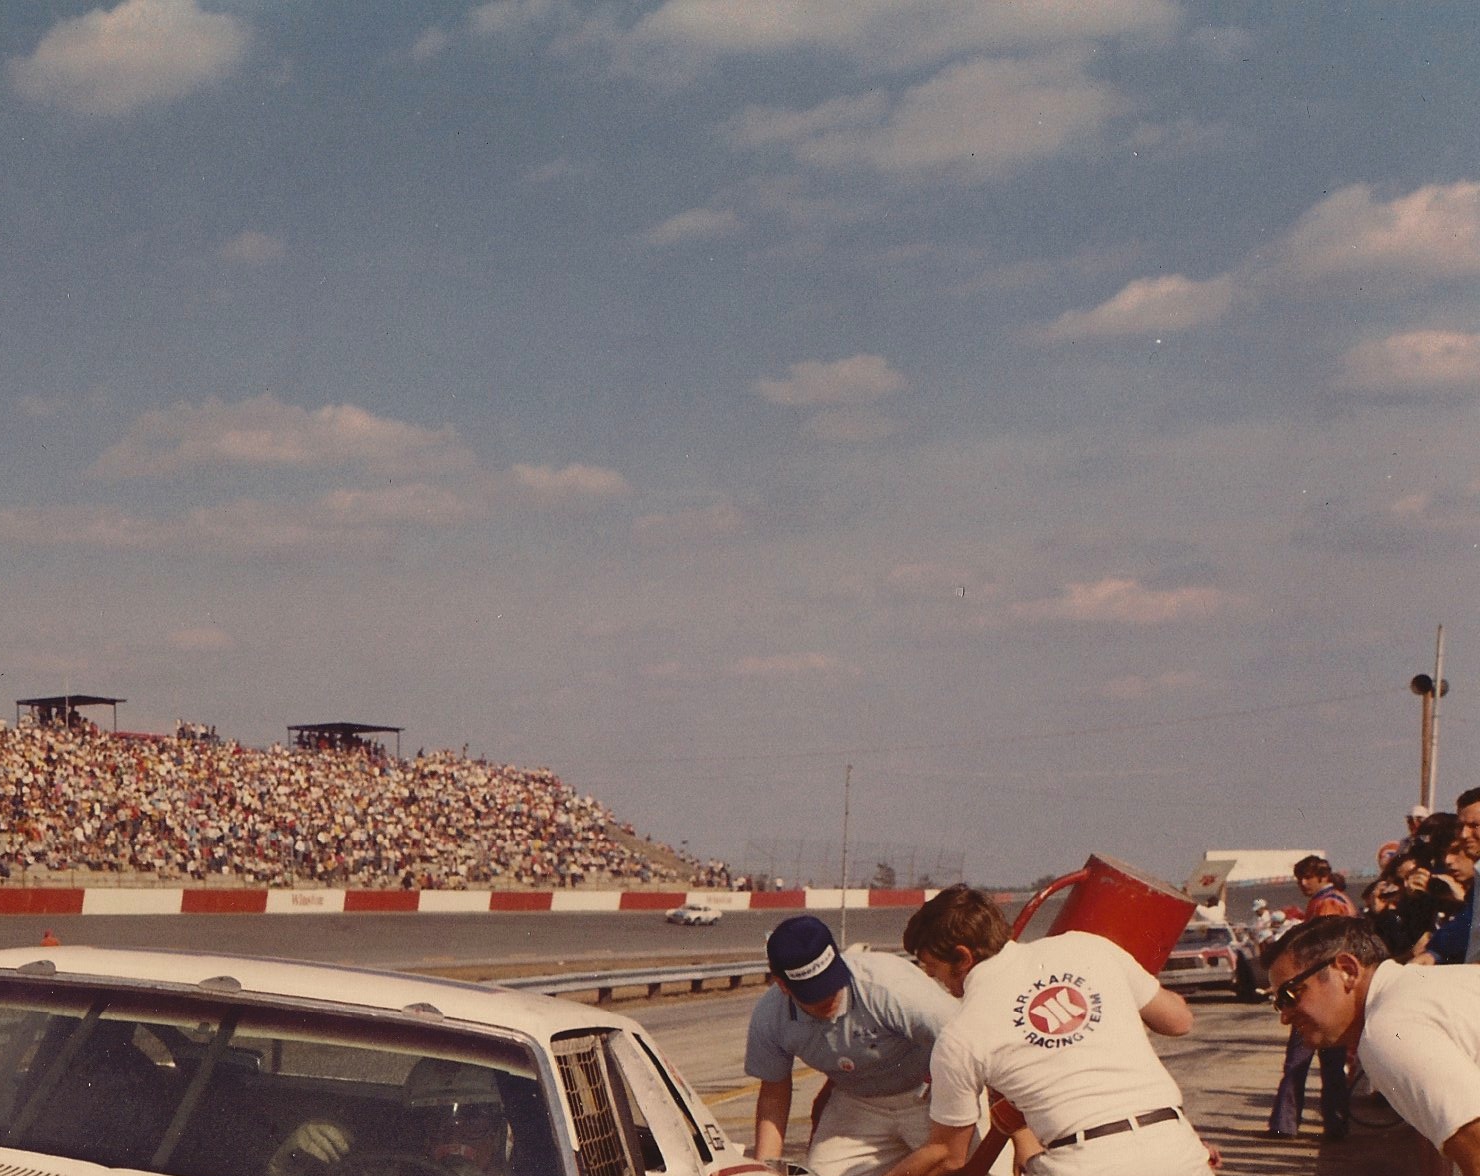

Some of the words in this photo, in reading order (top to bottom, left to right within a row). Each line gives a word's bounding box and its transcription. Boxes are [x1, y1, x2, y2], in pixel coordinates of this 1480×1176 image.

[1013, 973, 1086, 1028] KAR-KARE
[1024, 1031, 1085, 1049] RACING
[1082, 992, 1102, 1032] TEAM
